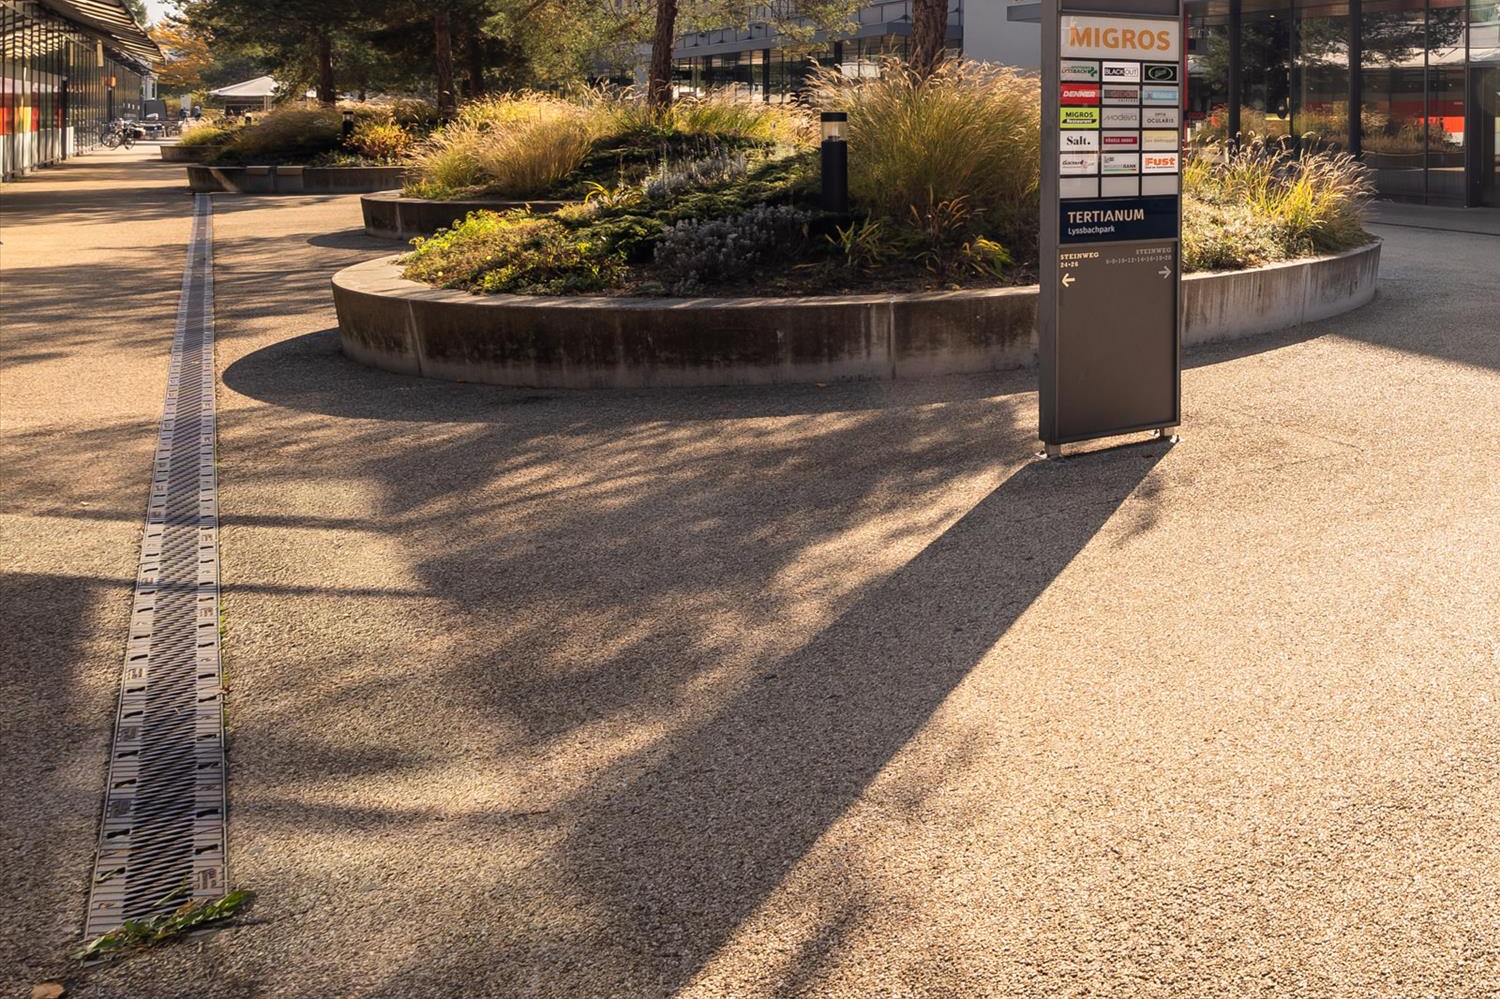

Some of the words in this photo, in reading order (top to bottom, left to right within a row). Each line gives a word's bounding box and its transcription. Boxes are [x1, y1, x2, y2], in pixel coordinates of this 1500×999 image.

[1069, 26, 1171, 51] MIGROS
[1066, 135, 1091, 145] Salt.
[1067, 208, 1145, 224] TERTIANUM
[1068, 225, 1115, 236] Lyssbachpark
[1060, 252, 1099, 260] STEINWEG
[1136, 247, 1172, 255] STEINWEG
